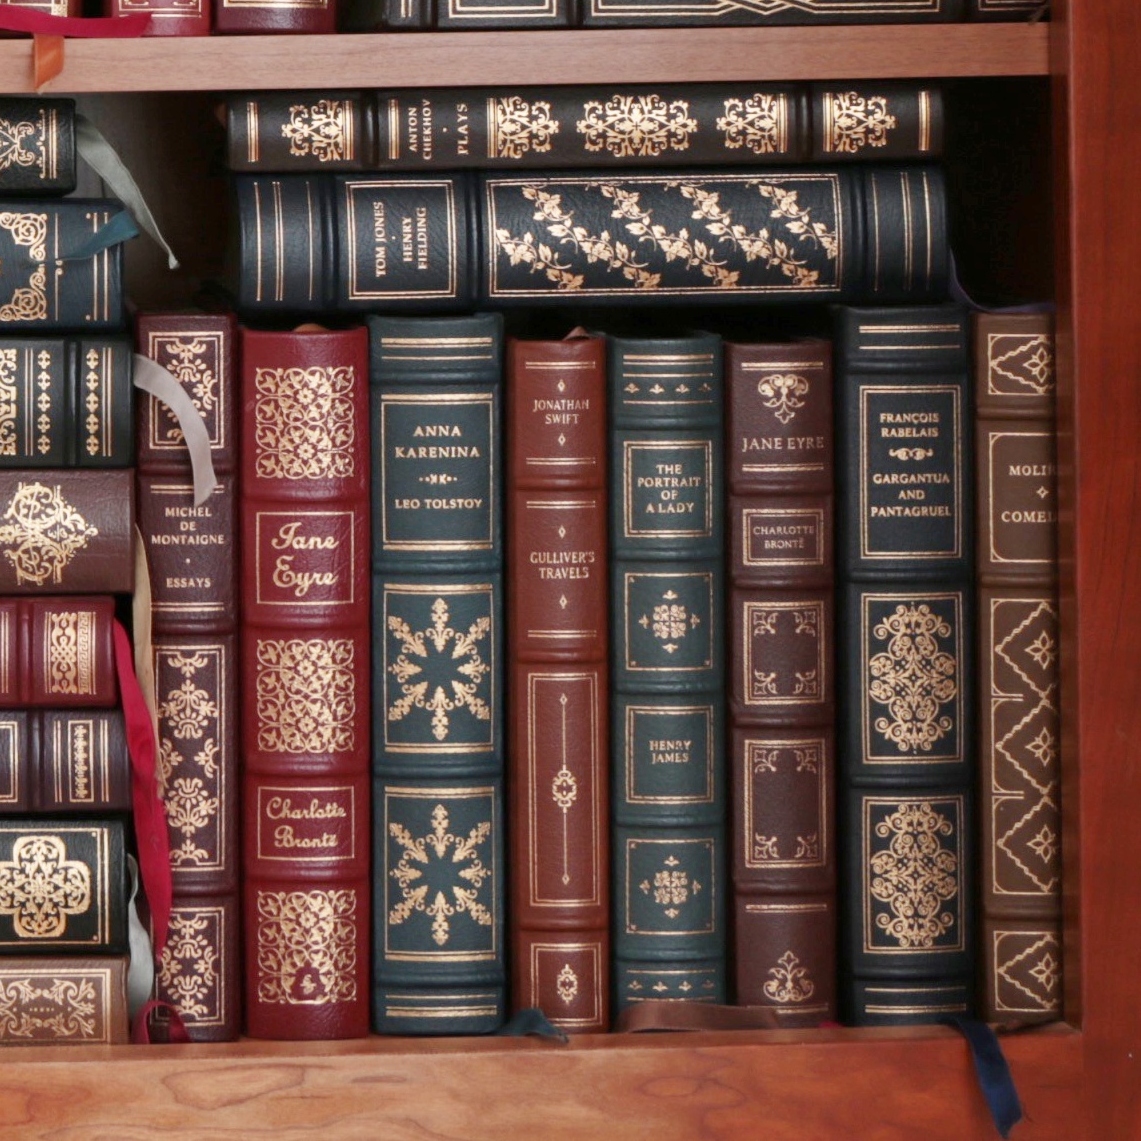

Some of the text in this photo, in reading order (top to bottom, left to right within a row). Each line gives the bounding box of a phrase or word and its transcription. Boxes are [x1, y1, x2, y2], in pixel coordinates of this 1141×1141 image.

[373, 201, 387, 277] TOM JONES
[402, 217, 413, 262] HENRY
[416, 207, 428, 270] FIELDING
[545, 414, 579, 424] SWIFT
[880, 413, 939, 425] FRANÇOIS
[414, 426, 462, 437] ANNA
[881, 427, 938, 437] RABELAIS
[742, 437, 824, 452] JANE EYRE
[395, 447, 480, 458] KARENINA
[873, 473, 950, 484] GARGANTUA
[899, 490, 925, 499] AND
[395, 499, 482, 509] LEO TOLSTOY
[165, 507, 212, 517] MICHEL
[871, 506, 951, 517] PANTAGRUEL
[180, 521, 196, 531] DE
[151, 535, 225, 545] MONTAIGNE
[271, 522, 339, 550] Jane
[530, 551, 595, 564] GULLIVER'S
[273, 556, 339, 596] Eyre
[539, 567, 589, 579] TRAVELS
[166, 578, 211, 588] ESSAYS
[266, 797, 346, 819] Charlotte
